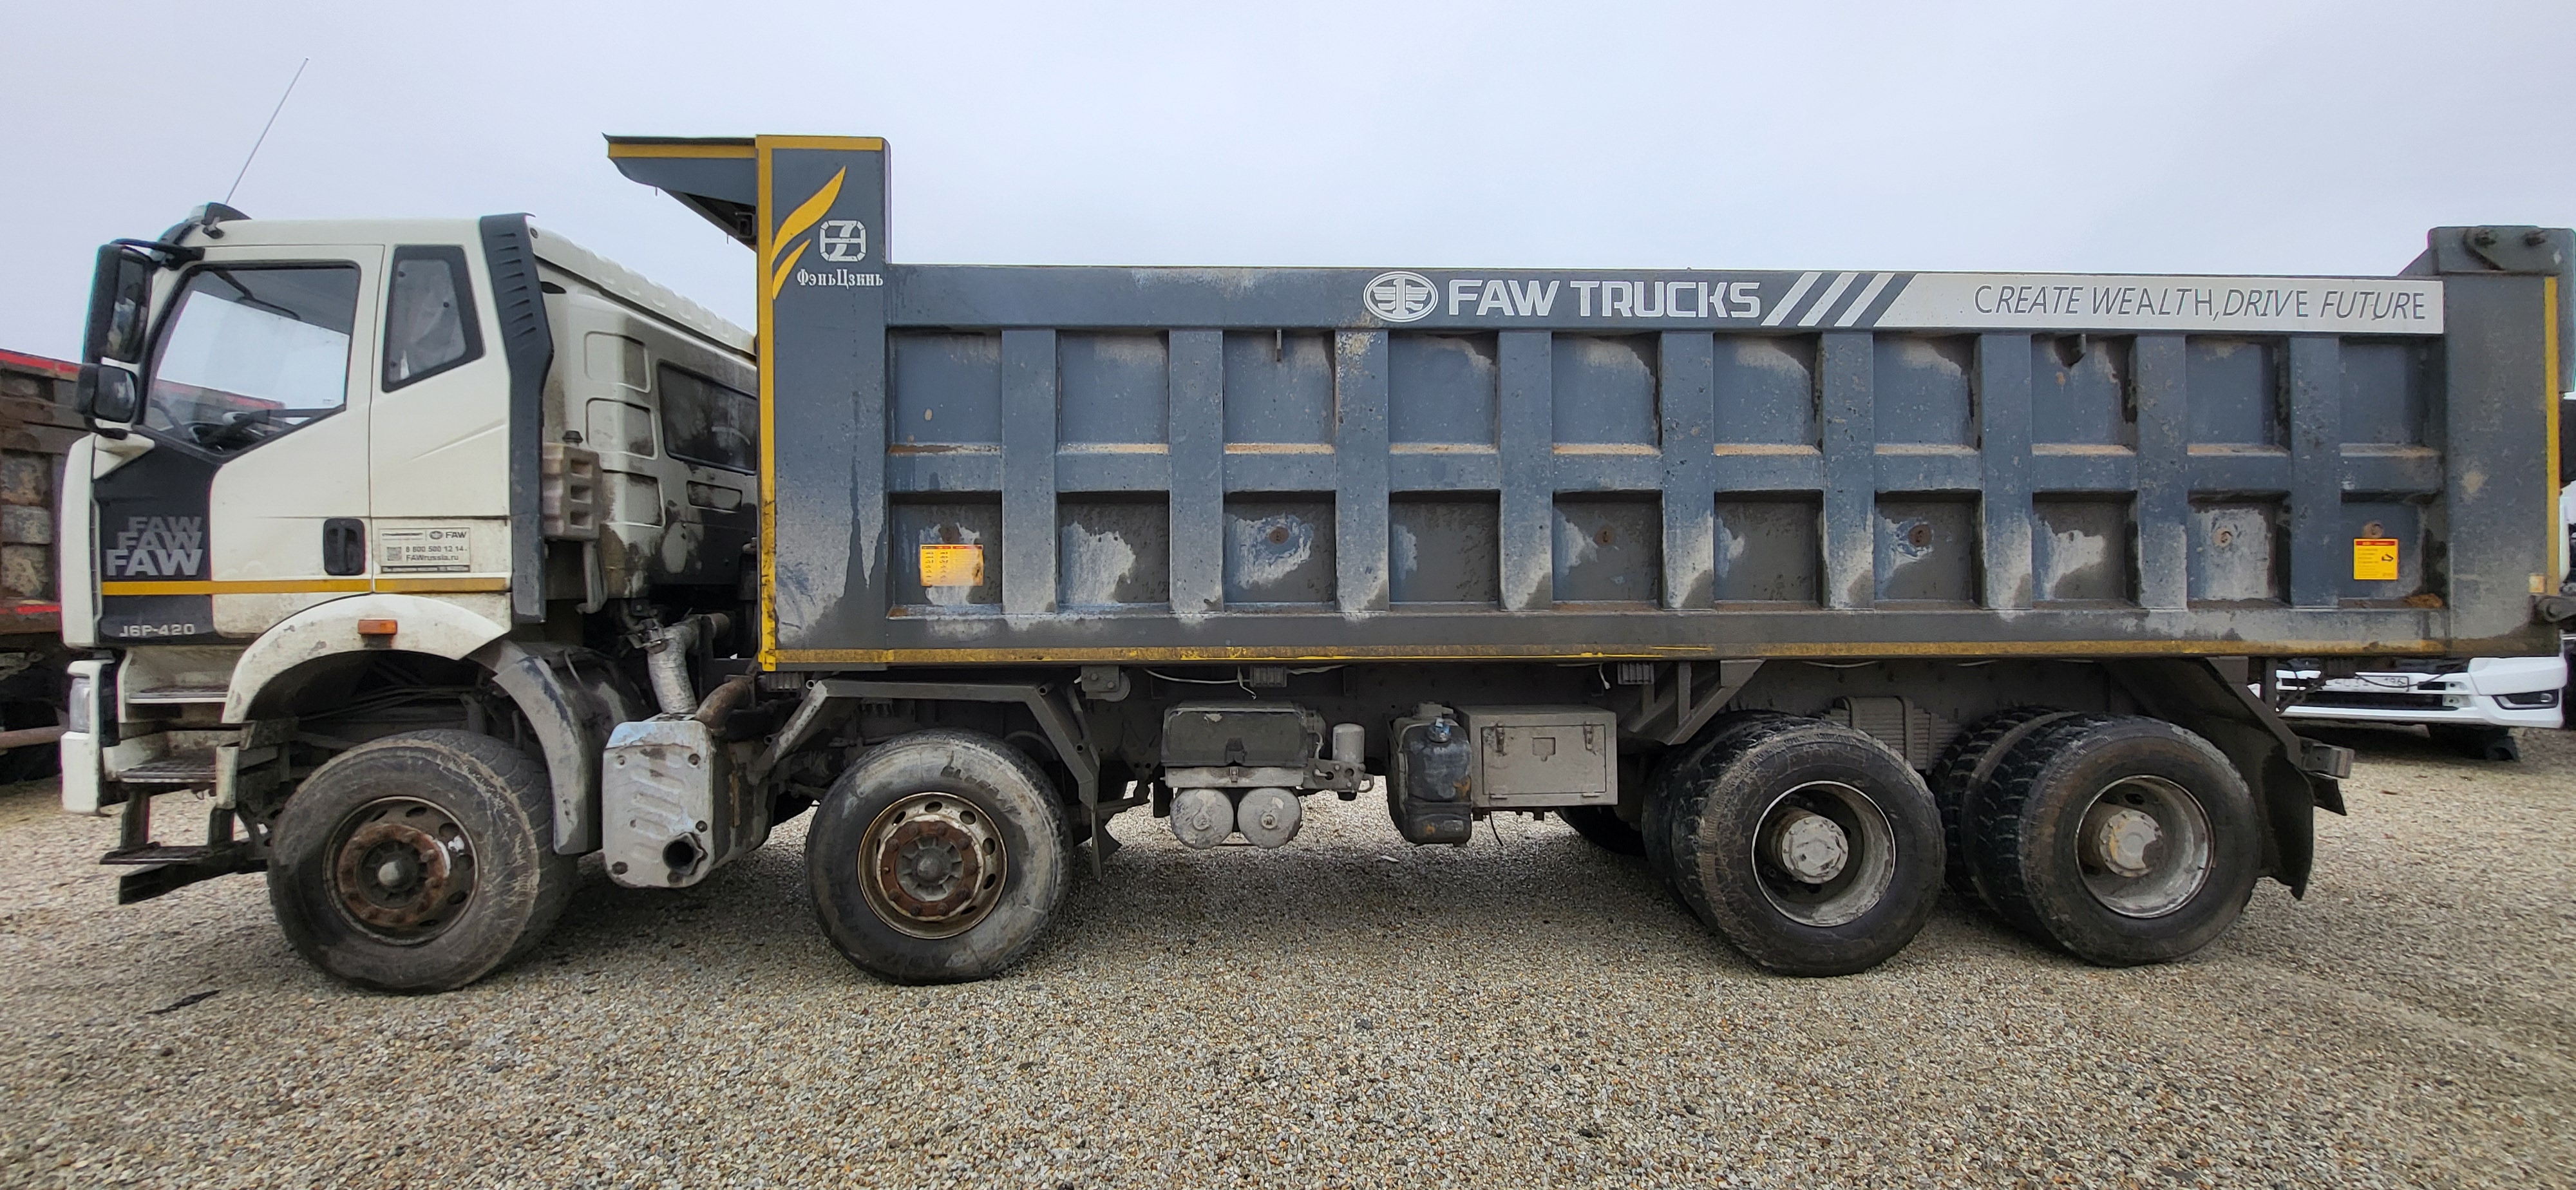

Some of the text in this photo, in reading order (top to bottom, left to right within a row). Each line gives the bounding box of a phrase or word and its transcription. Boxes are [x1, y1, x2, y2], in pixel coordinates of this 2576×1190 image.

[797, 269, 884, 289] ФэньЦзинь
[1448, 279, 1760, 318] FAW TRUCKS
[1974, 285, 2084, 315] CREATE
[2319, 290, 2427, 321] FUTURE
[128, 516, 202, 533] FAW
[117, 531, 203, 551] FAW
[106, 549, 204, 576] FAW
[119, 623, 196, 638] J6P-420
